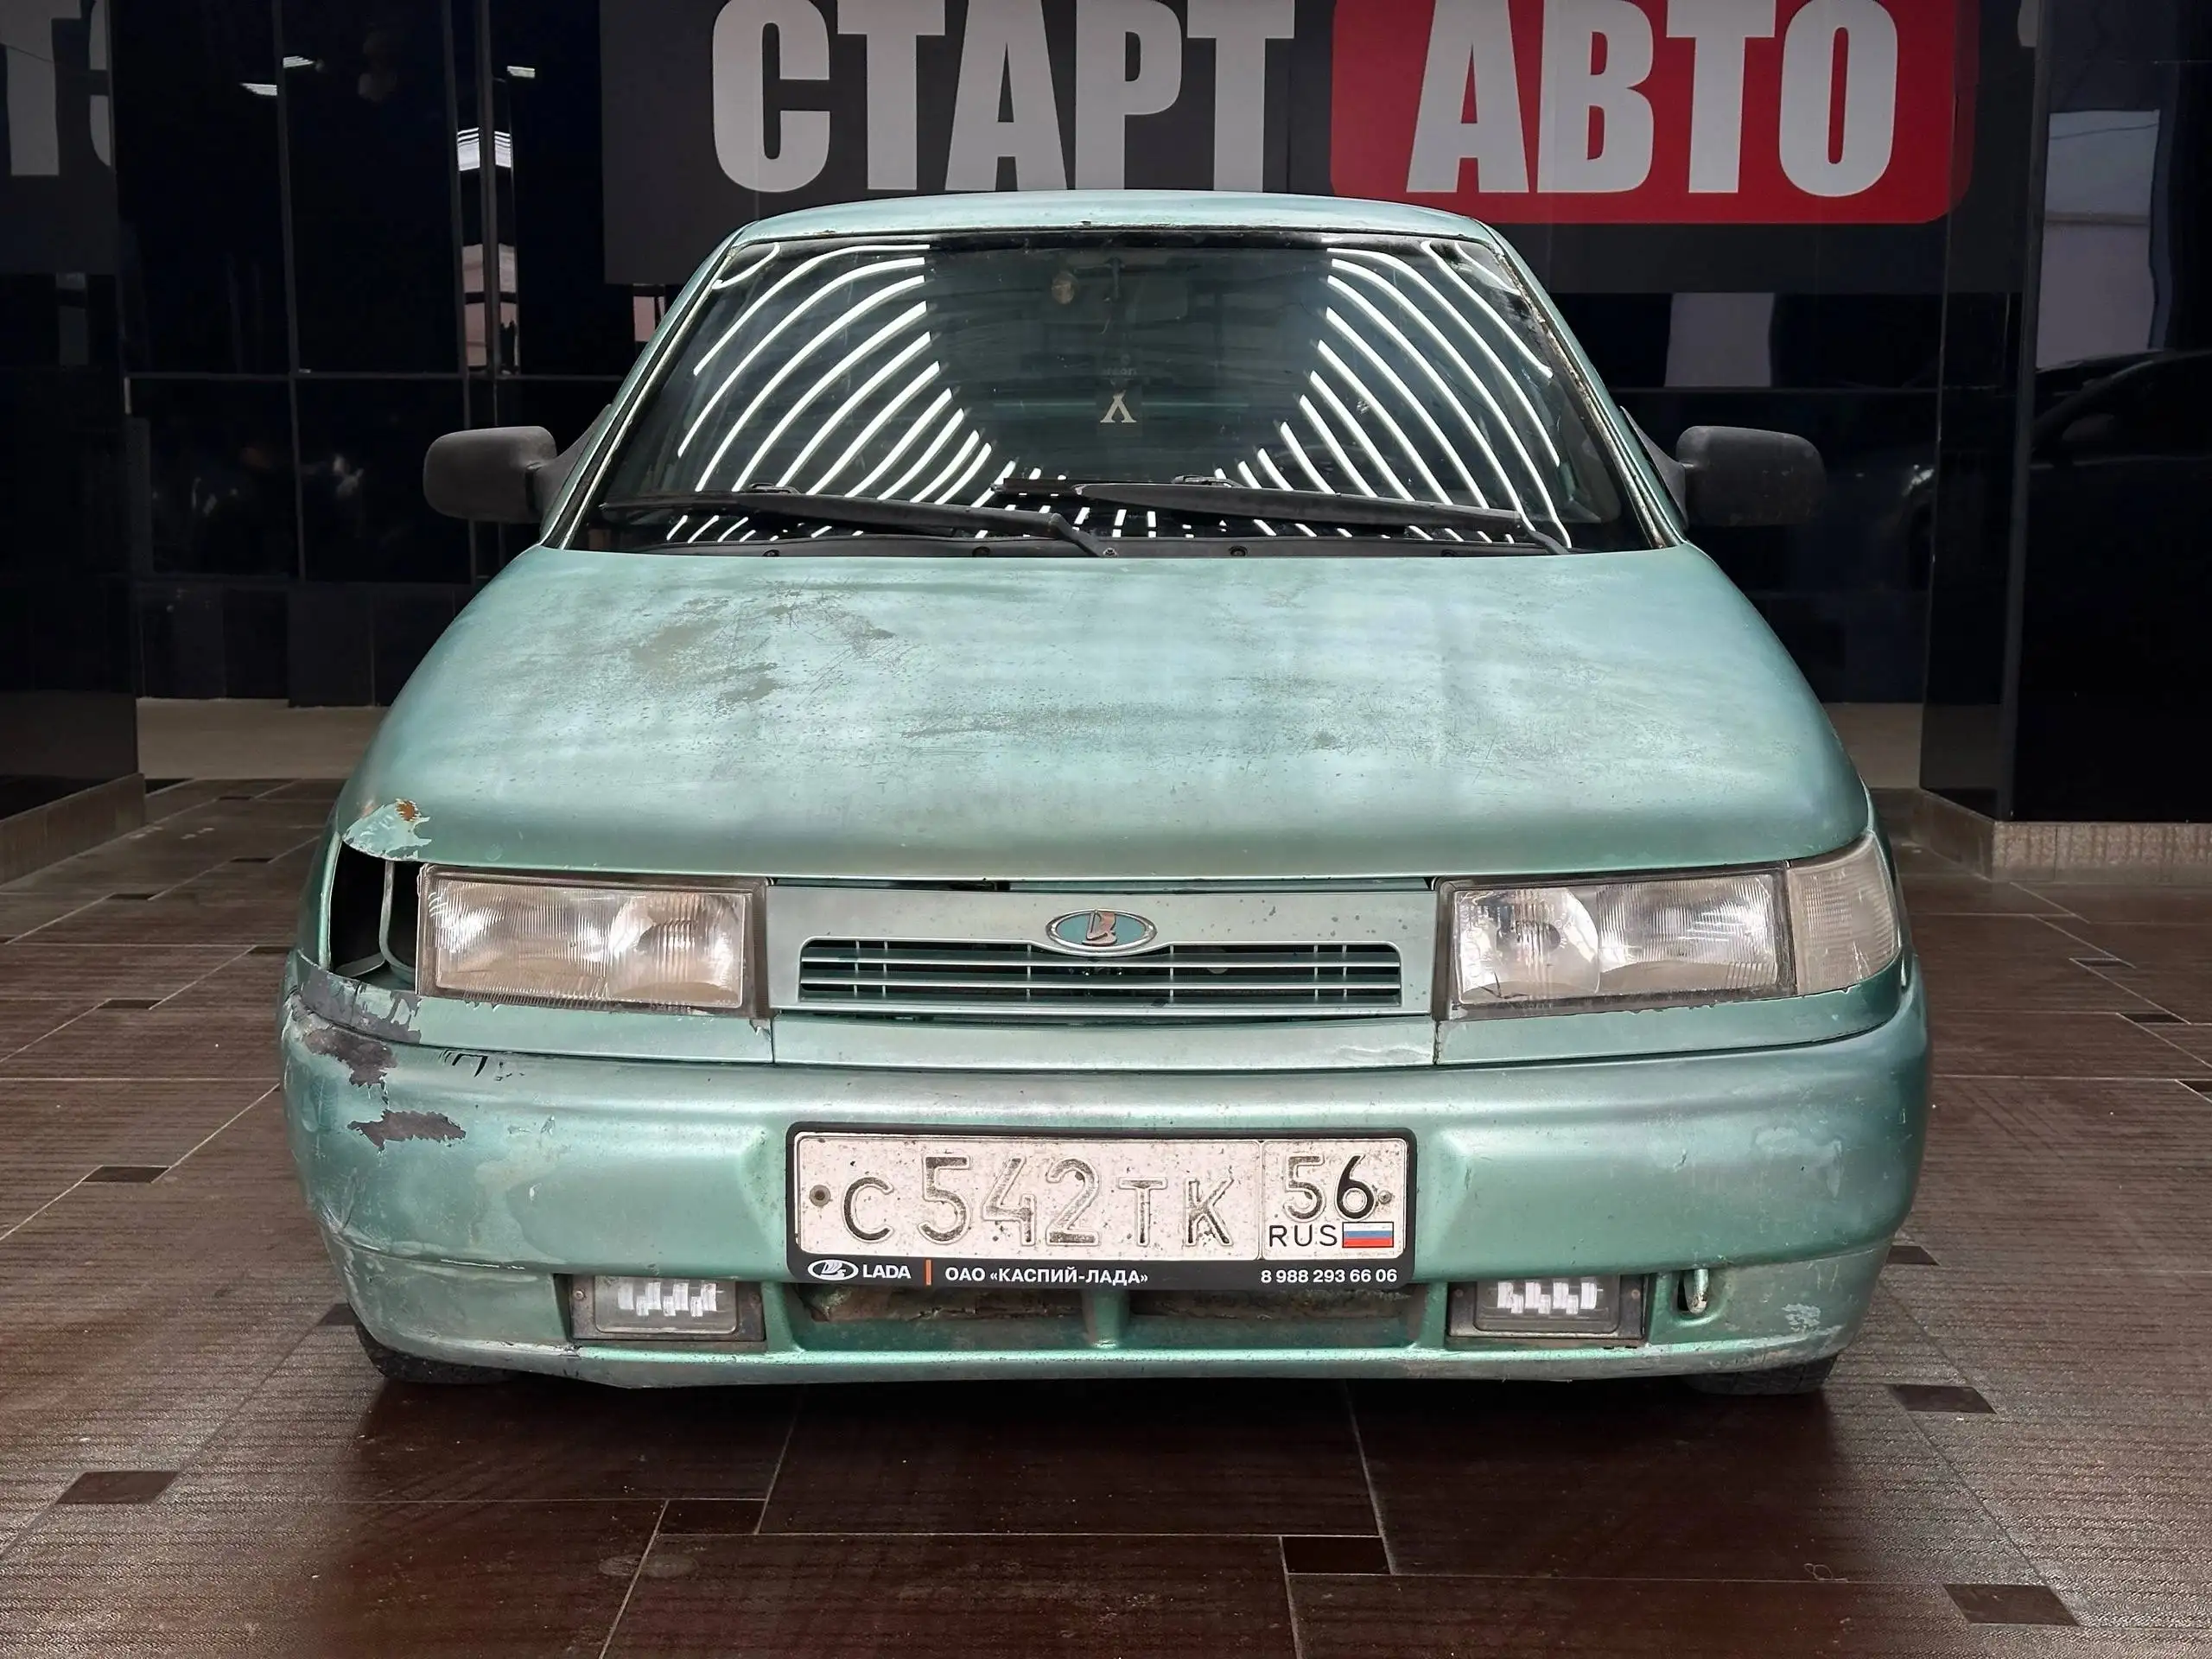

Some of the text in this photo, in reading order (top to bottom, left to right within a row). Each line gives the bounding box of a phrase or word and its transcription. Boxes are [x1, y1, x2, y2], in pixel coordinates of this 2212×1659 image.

[712, 0, 1898, 197] СТАРТ АВТО
[1284, 1154, 1375, 1220] 56
[1268, 1224, 1338, 1248] RUS
[862, 1263, 912, 1280] LADA
[944, 1265, 1149, 1285] ОАО «КАСПИЙ-ЛАДА»
[1261, 1268, 1398, 1283] 8 988 293 66 06
